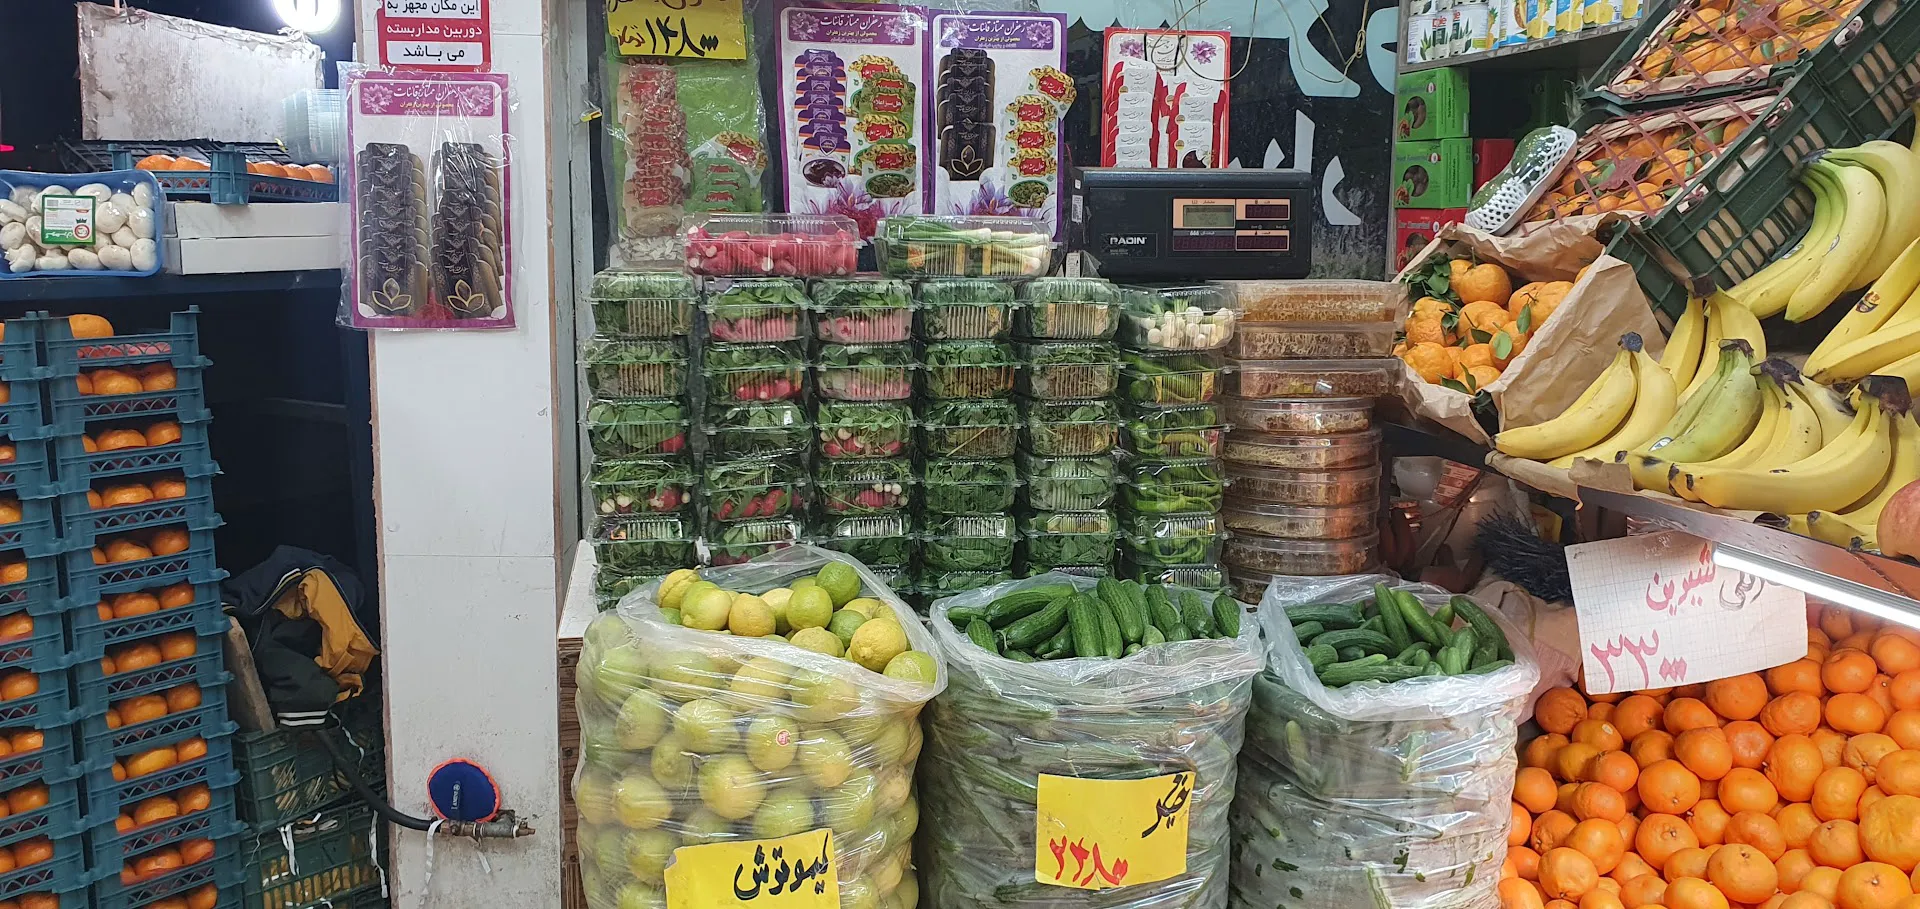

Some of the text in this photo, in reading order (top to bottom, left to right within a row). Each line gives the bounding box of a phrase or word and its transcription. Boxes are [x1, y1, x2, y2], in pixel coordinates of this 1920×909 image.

[387, 0, 479, 14] این مکان مجهز به
[845, 13, 859, 26] ممتاز
[860, 13, 884, 30] زعفران
[990, 20, 1005, 32] ممتاز
[386, 23, 483, 38] دوربین مداربسته
[1004, 21, 1026, 36] زعفران
[403, 44, 465, 61] می باشد
[1109, 237, 1146, 245] RADIN
[1645, 542, 1717, 616] شیرین
